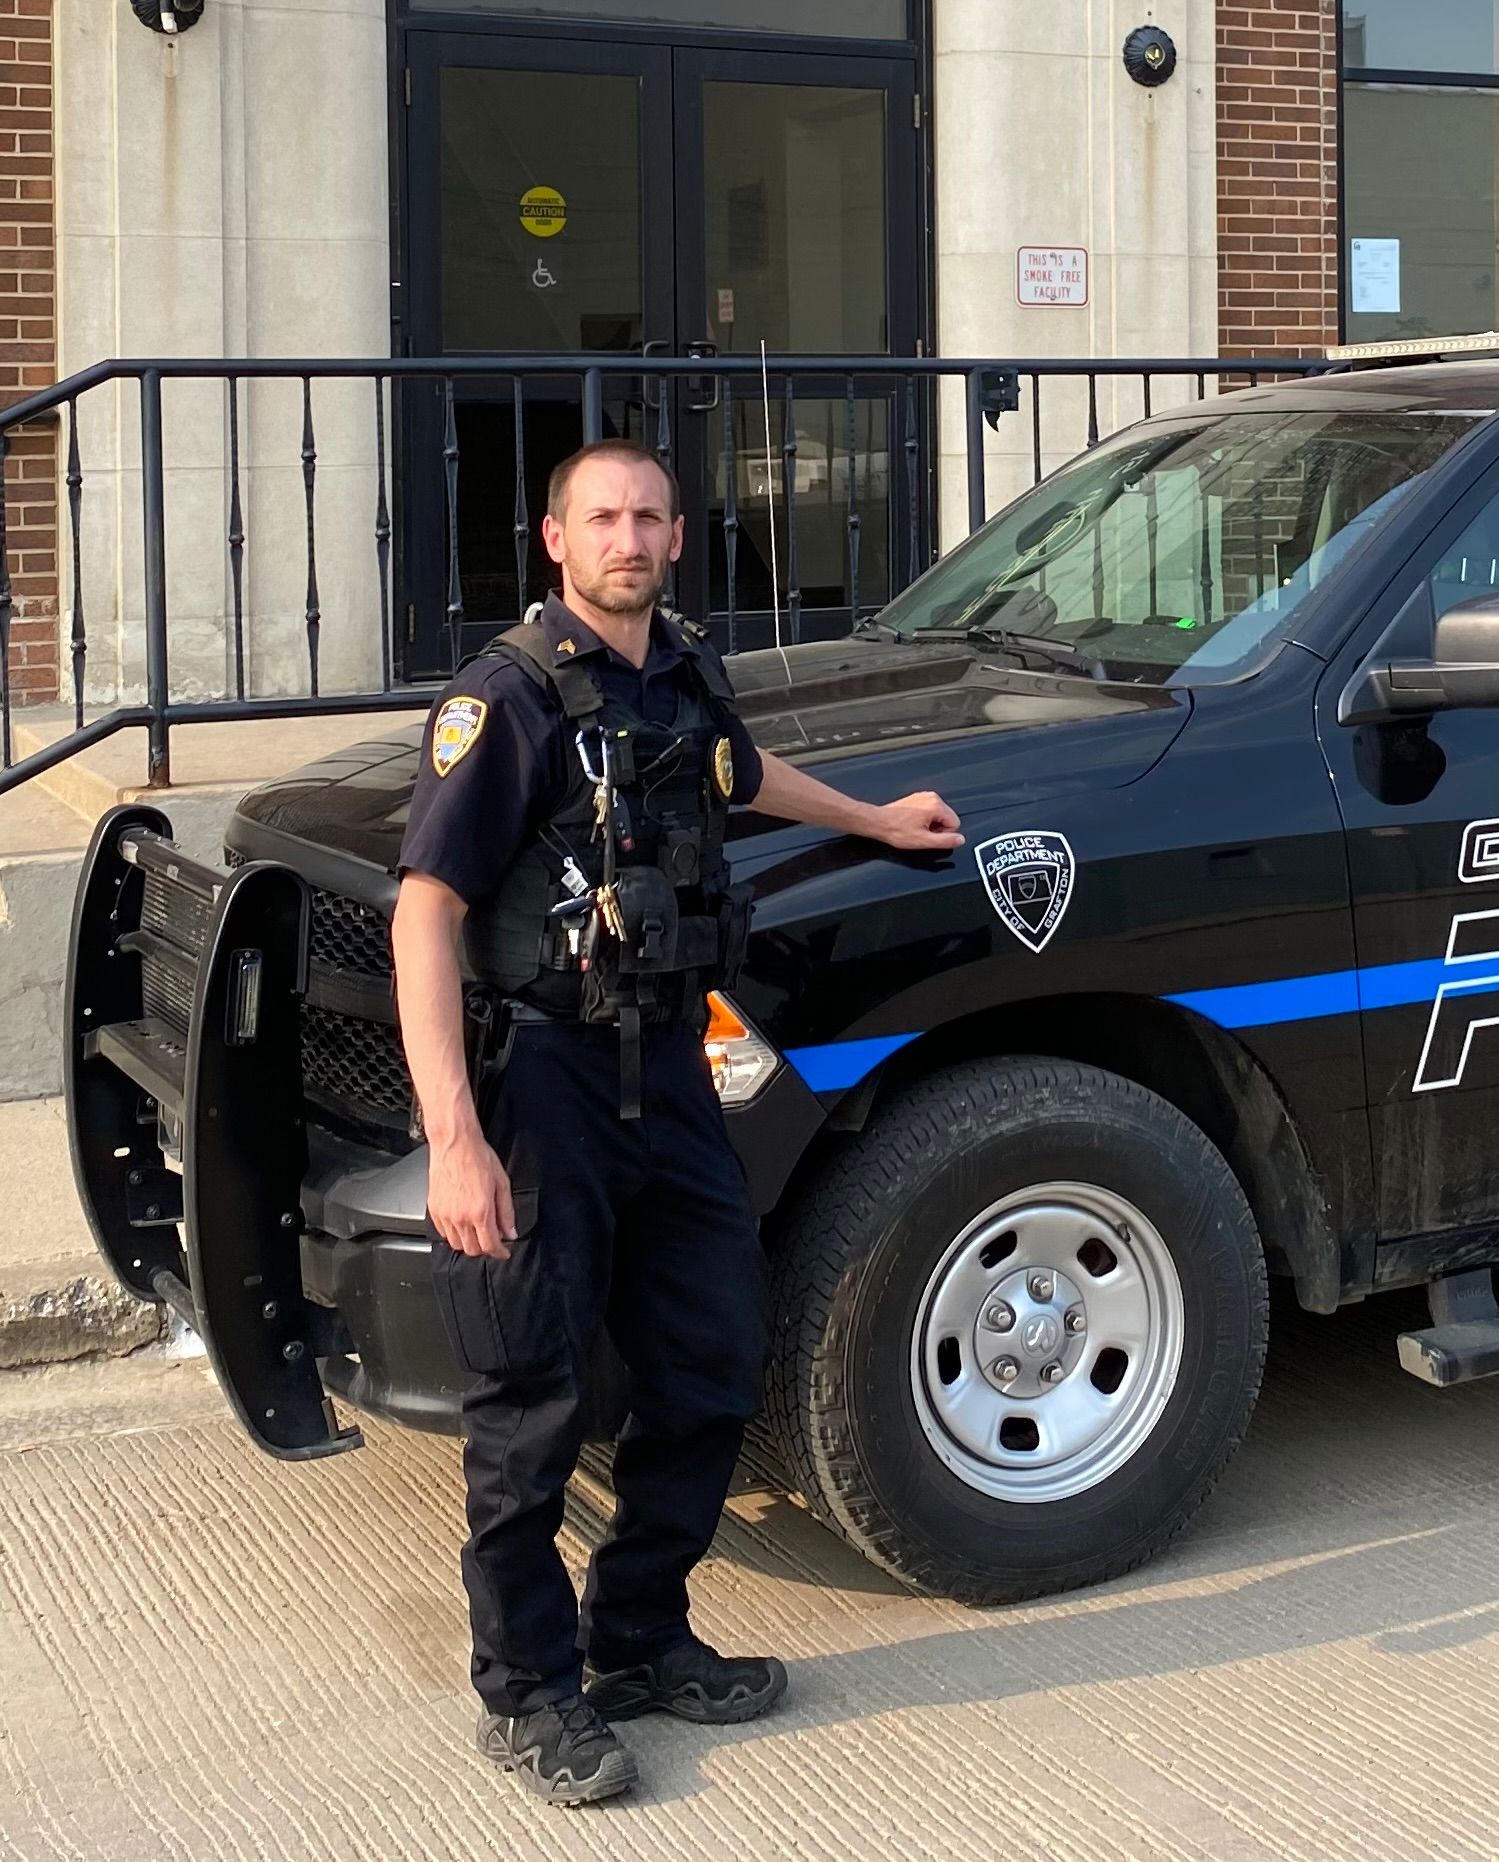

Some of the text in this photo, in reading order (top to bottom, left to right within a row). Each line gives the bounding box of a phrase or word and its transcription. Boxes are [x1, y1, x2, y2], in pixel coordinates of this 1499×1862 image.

[522, 206, 565, 217] CAUTION
[1028, 253, 1078, 267] THIS IS A
[1024, 270, 1081, 283] SMOKE FREE
[1033, 286, 1071, 299] FACILITY
[995, 837, 1046, 855] POLICE
[986, 848, 1065, 876] DEPARTMENT
[1043, 868, 1069, 929] GRAFTON
[992, 888, 1026, 931] CITY OF
